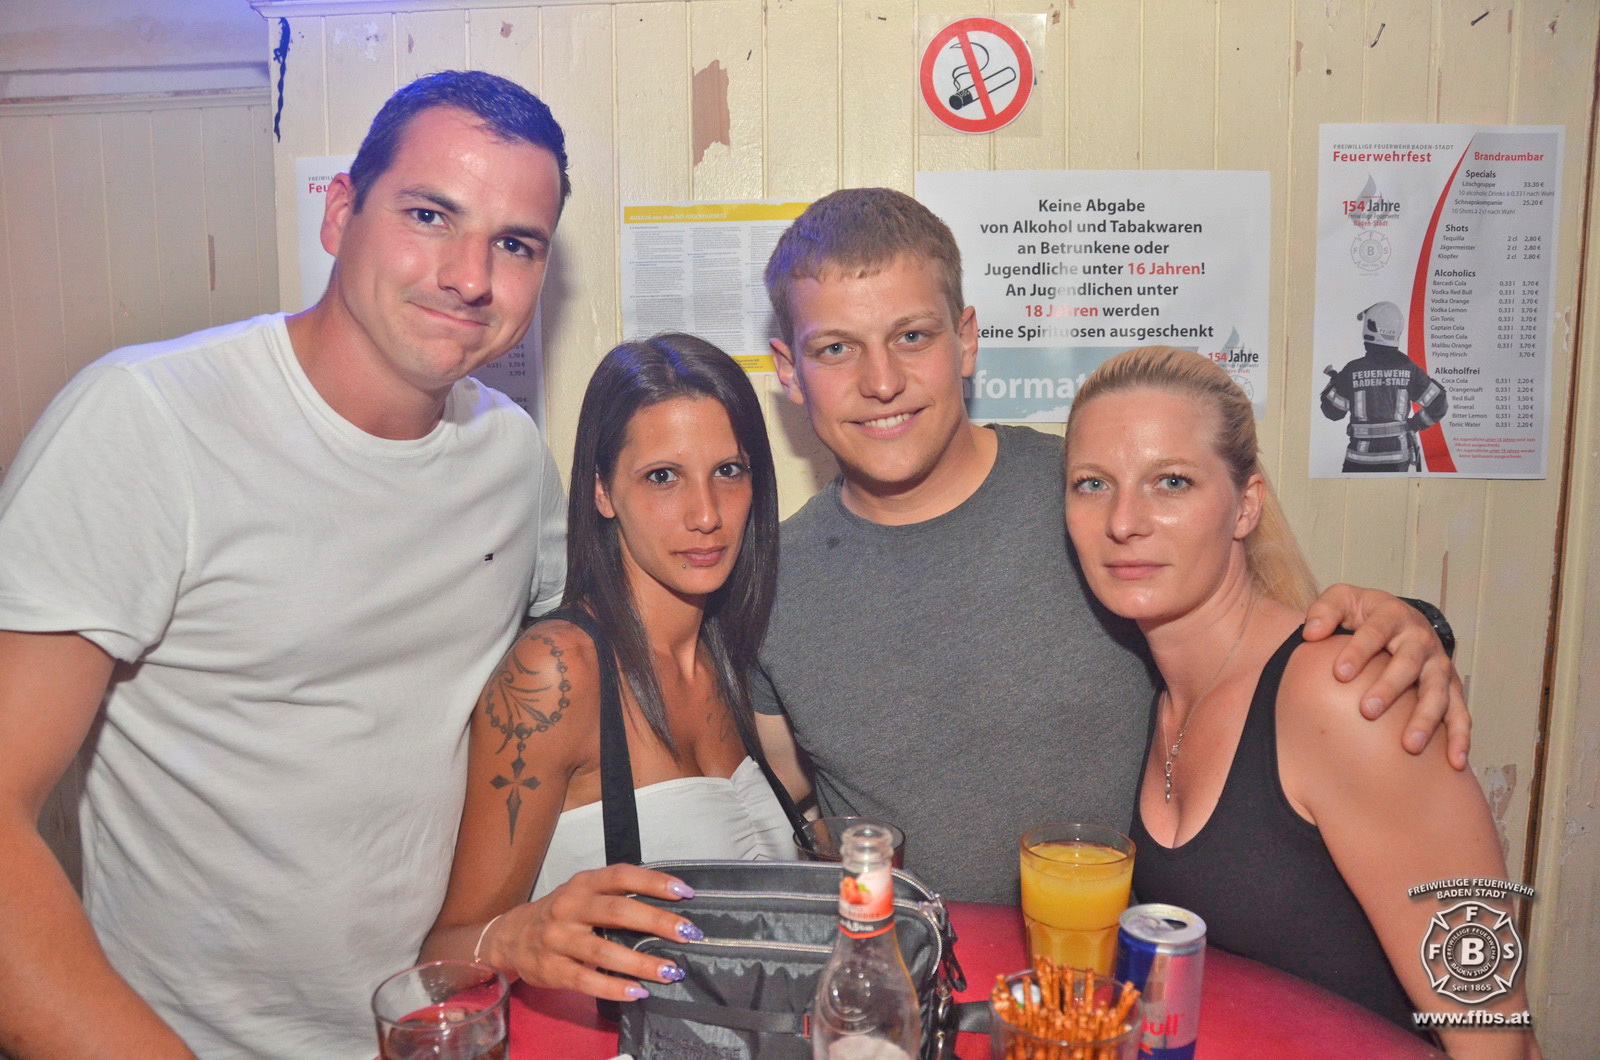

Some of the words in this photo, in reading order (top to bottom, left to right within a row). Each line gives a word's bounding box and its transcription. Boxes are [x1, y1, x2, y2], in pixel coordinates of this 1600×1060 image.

[1333, 151, 1431, 162] Feuerwehrfest
[1474, 152, 1544, 161] Brandraumbar
[1465, 169, 1496, 179] Specials
[1039, 199, 1082, 212] Keine
[1086, 198, 1145, 215] Abgabe
[1343, 200, 1365, 215] 154
[1367, 199, 1400, 212] Jahre
[980, 224, 1009, 233] von
[1013, 220, 1072, 233] Alkohol
[1077, 220, 1106, 233] und
[1110, 220, 1202, 233] Tabakwaren
[1445, 224, 1469, 232] Shots
[1017, 244, 1036, 254] an
[1041, 240, 1130, 254] Betrunkene
[1134, 240, 1170, 254] oder
[984, 262, 1078, 278] Jugendliche
[1082, 263, 1124, 275] unter
[1128, 262, 1146, 275] 16
[1149, 262, 1205, 275] Jahren!
[1434, 269, 1476, 277] Alcoholics
[1006, 284, 1026, 296] An
[1030, 282, 1132, 300] Jugendlichen
[1137, 284, 1179, 296] unter
[1025, 304, 1043, 317] 18
[1046, 304, 1099, 317] Jahren
[1103, 303, 1159, 317] werden
[1018, 325, 1105, 341] Spirituosen
[1110, 324, 1214, 341] ausgeschenkt
[1228, 349, 1259, 363] Jahre
[1352, 369, 1411, 380] FEUERWEHR
[1434, 367, 1480, 375] Alkoholfrei
[1352, 378, 1410, 388] BADEN-STADT
